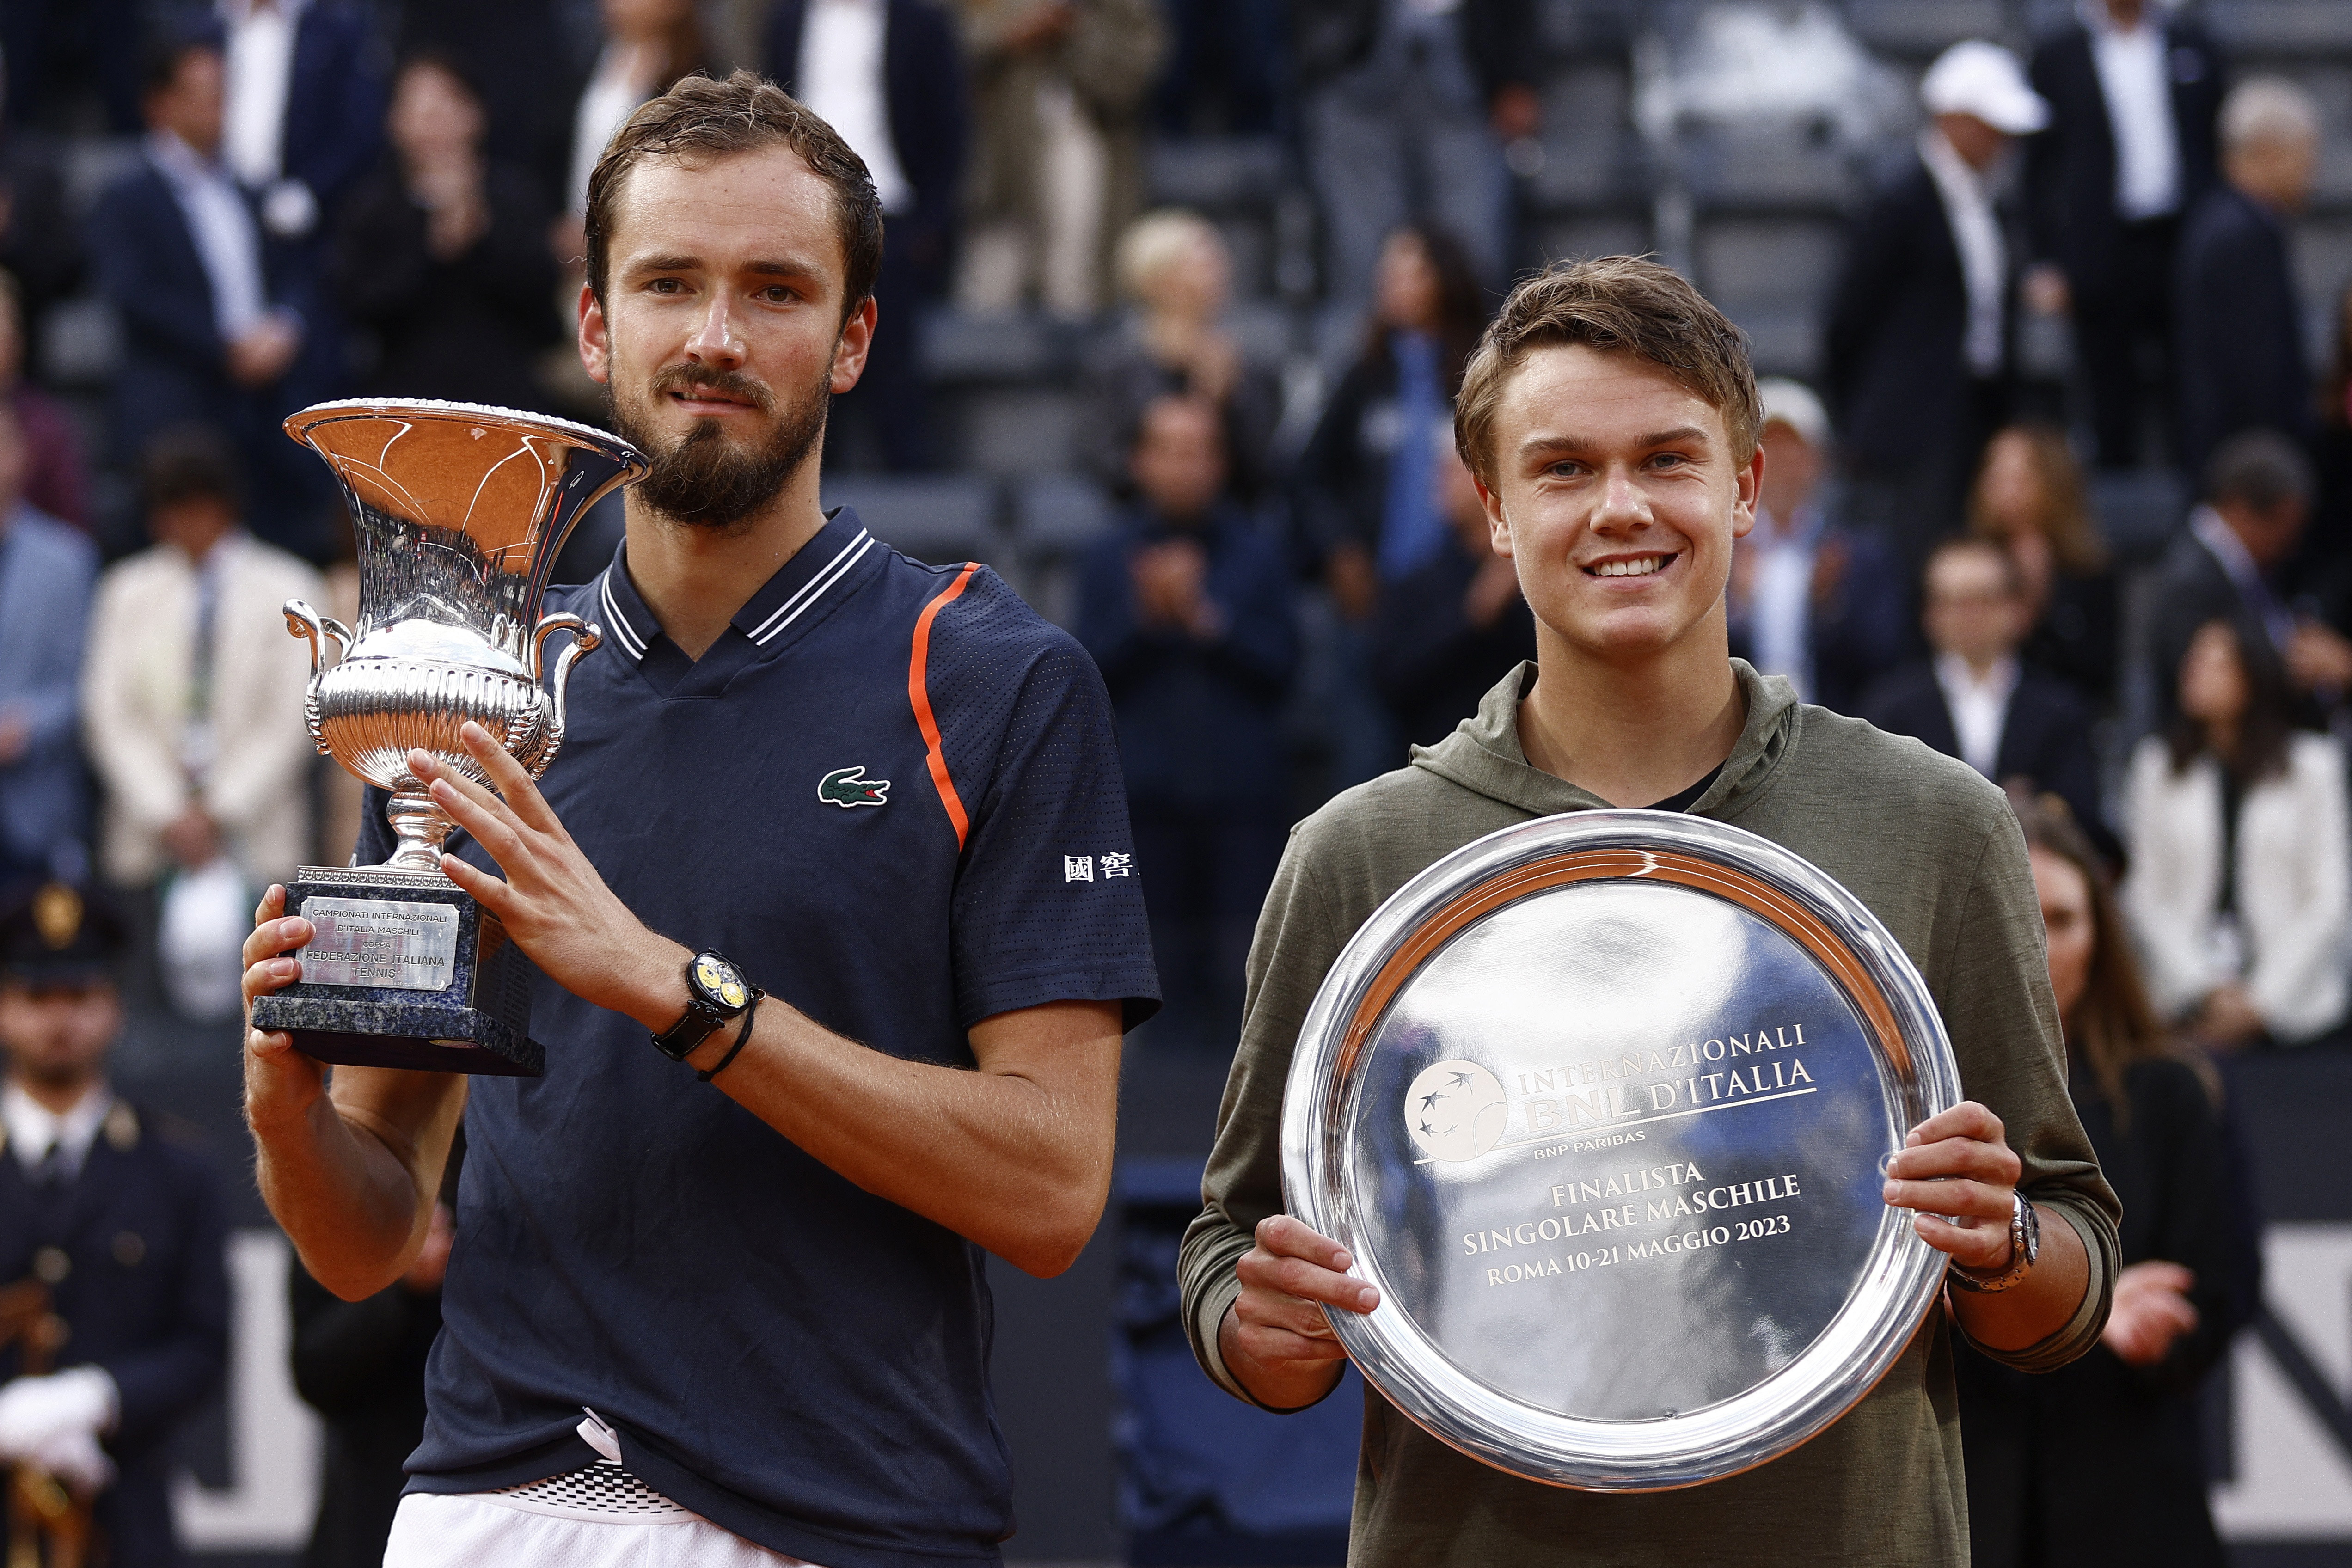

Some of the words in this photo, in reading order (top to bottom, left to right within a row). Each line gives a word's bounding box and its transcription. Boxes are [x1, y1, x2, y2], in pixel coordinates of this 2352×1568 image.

[1064, 852, 1140, 883] 國窖
[313, 909, 368, 919] CAMPIONATI
[372, 913, 447, 923] INTERNAZIONALI
[337, 925, 374, 933] D'ITALIA
[306, 950, 387, 964] FEDERAZIONE
[392, 954, 445, 967] ITALIANA
[352, 967, 396, 978] TENNIS
[1519, 1023, 1807, 1096] INTERNAZIONALI
[1526, 1087, 1641, 1133] BNL
[1649, 1058, 1815, 1111] D'ITALIA
[1534, 1144, 1569, 1160] BNP
[1573, 1131, 1646, 1153] PARIBAS
[1550, 1161, 1706, 1208] FINALISTA
[1463, 1204, 1638, 1256] SINGOLARE
[1646, 1174, 1801, 1221] MASCHILE
[1486, 1257, 1563, 1287] ROMA
[1566, 1246, 1622, 1272] 10-21
[1626, 1226, 1730, 1260] MAGGIO
[1736, 1215, 1791, 1240] 2023
